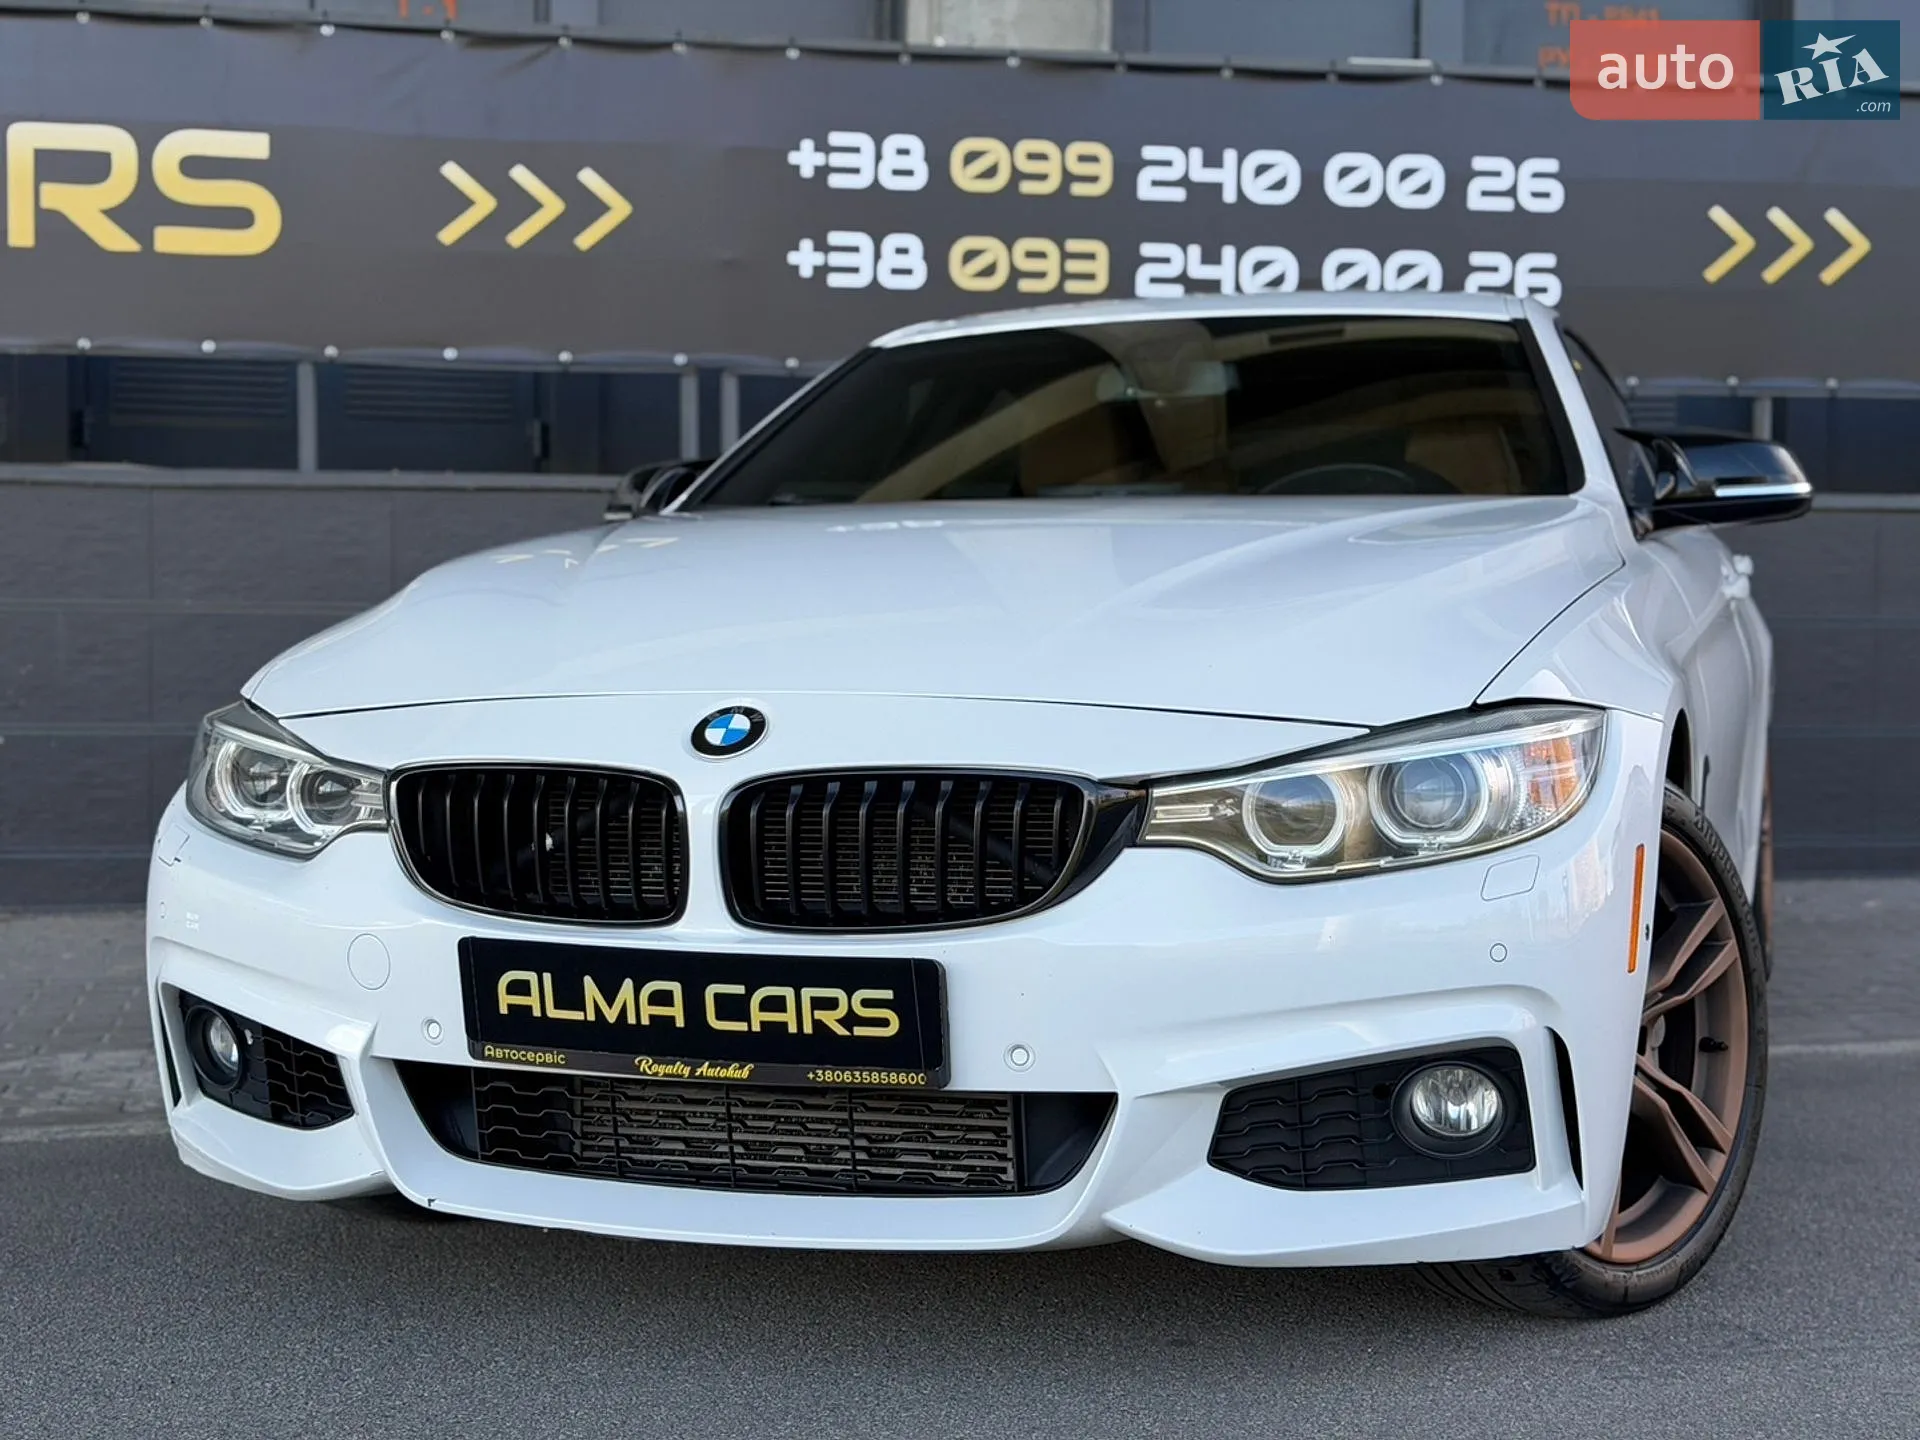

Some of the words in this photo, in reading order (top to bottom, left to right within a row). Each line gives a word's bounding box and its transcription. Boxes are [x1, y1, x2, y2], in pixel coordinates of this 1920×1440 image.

[6, 121, 282, 256] RS
[787, 130, 930, 192] +38
[949, 136, 1115, 197] 099
[1136, 144, 1302, 206] 240
[1323, 151, 1446, 210] 00
[1466, 155, 1566, 214] 26
[786, 230, 928, 291] +38
[949, 235, 1111, 295] 093
[1134, 242, 1300, 297] 240
[1321, 248, 1443, 292] 00
[1463, 251, 1562, 307] 26
[497, 970, 685, 1028] ALMA
[705, 983, 901, 1037] CARS
[484, 1045, 566, 1064] Автосервіс
[634, 1055, 692, 1077] Royalty
[693, 1060, 755, 1079] Autohub
[806, 1069, 927, 1085] +380635858600
